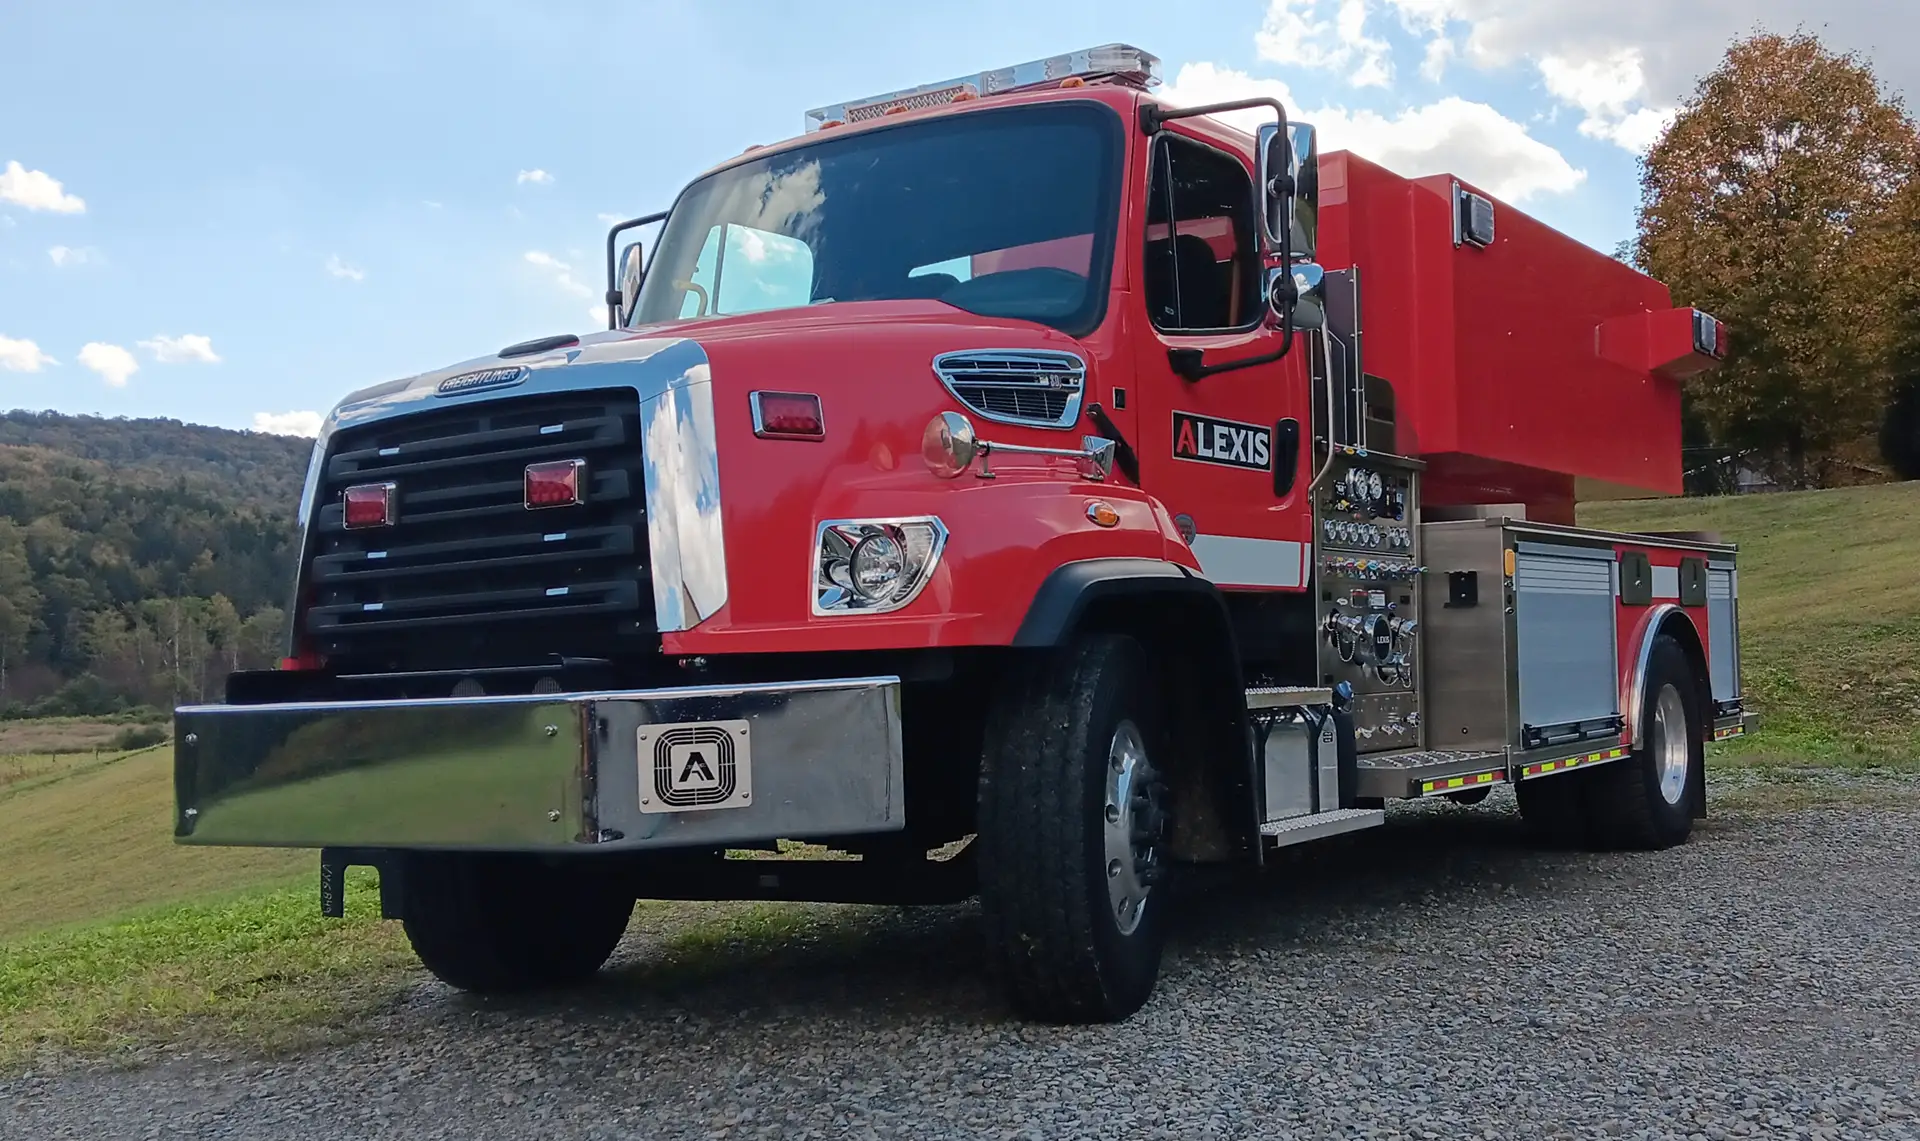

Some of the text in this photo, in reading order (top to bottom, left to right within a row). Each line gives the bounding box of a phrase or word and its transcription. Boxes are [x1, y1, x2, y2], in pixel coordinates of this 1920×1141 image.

[440, 368, 518, 390] FREIGHTLINER
[1176, 419, 1269, 466] ALEXIS
[678, 751, 716, 783] A
